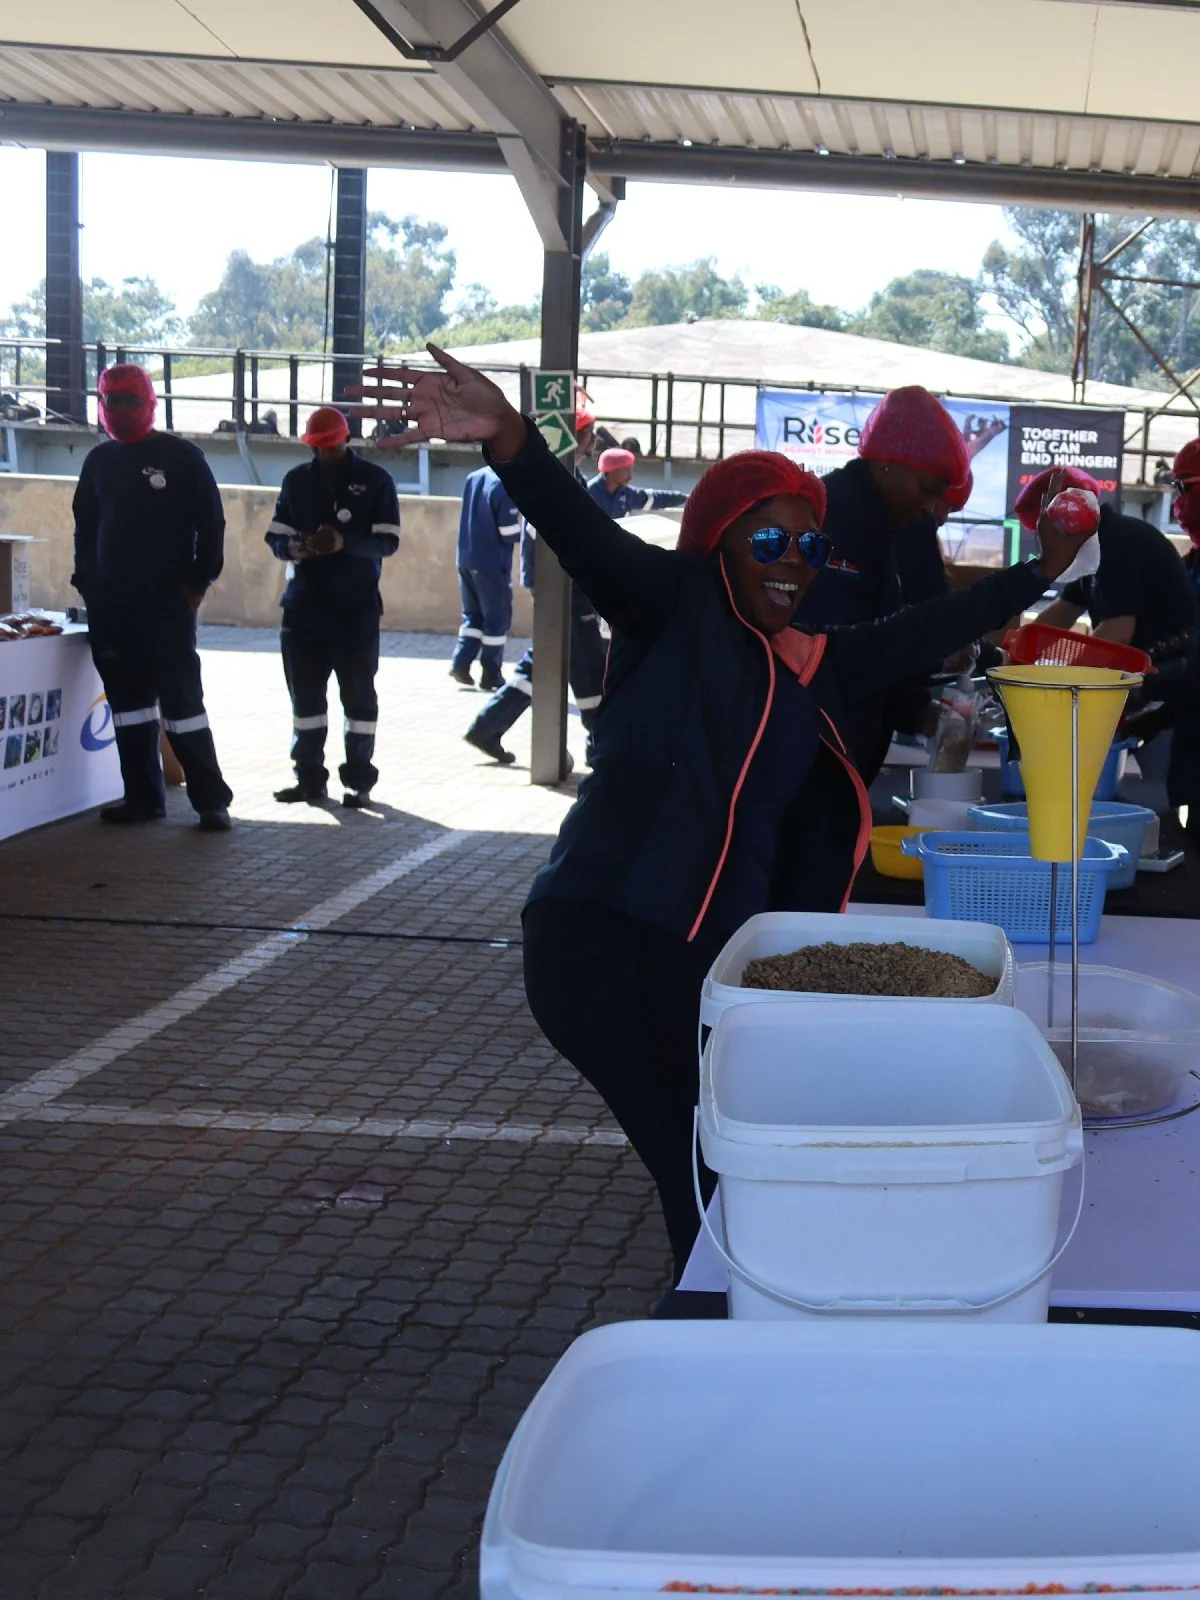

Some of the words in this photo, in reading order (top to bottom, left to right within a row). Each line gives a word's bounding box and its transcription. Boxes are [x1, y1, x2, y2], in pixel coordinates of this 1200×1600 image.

[1022, 427, 1098, 443] TOGETHER
[1022, 439, 1042, 453] WE
[1049, 441, 1080, 454] CAN
[1021, 452, 1051, 466] END
[1054, 454, 1117, 468] HUNGER!
